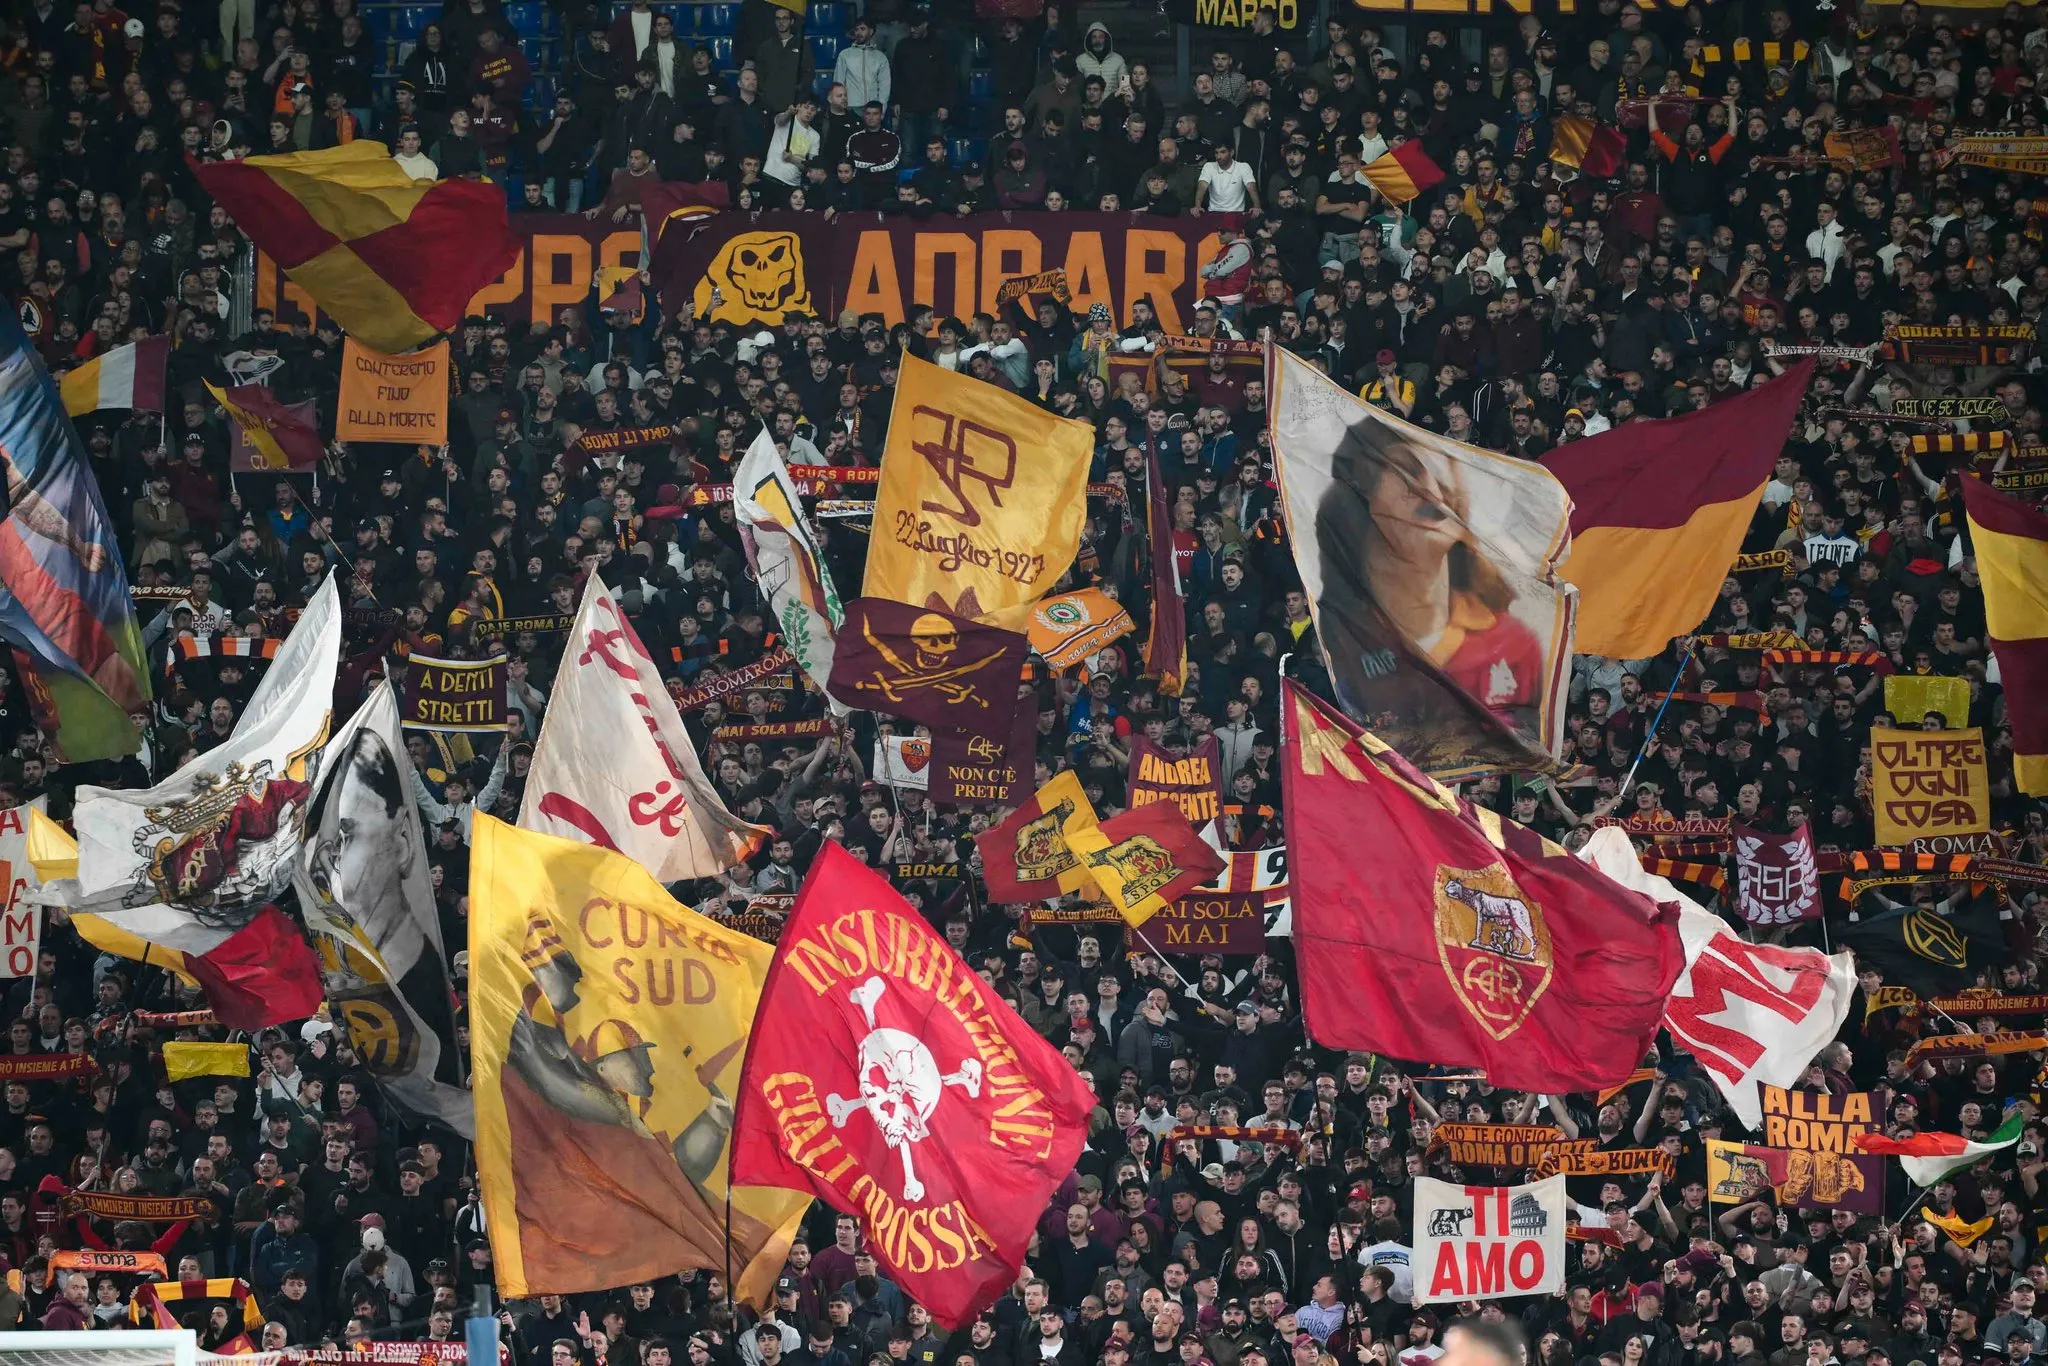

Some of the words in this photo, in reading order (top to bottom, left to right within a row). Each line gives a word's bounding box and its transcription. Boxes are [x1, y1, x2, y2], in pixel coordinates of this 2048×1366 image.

[1233, 342, 1265, 352] AM
[356, 357, 435, 376] CANTEREMO
[377, 386, 409, 400] FINO
[1896, 400, 1918, 415] CHI
[348, 409, 385, 424] ALLA
[389, 412, 436, 427] MORTE
[847, 469, 879, 481] ROM
[896, 510, 915, 547] 22
[913, 522, 994, 572] Luglio
[994, 549, 1045, 585] 1927
[515, 618, 554, 631] ROMA
[1738, 631, 1793, 648] 1927
[420, 668, 433, 690] A
[440, 667, 494, 693] DENTI
[417, 699, 493, 723] STRETTI
[717, 725, 743, 738] MAI
[751, 724, 786, 736] SOLA
[795, 720, 821, 733] MAI
[1877, 740, 1982, 769] OLTRE
[948, 766, 984, 782] NON
[1137, 754, 1211, 786] ANDREA
[955, 784, 1009, 800] PRETE
[1890, 769, 1969, 797] OGNI
[1886, 800, 1976, 828] COSA
[1914, 834, 1993, 854] ROMA
[898, 863, 959, 878] ROMA
[1030, 909, 1055, 920] ROMA
[1058, 910, 1079, 921] CLUB
[1192, 899, 1254, 920] SOLA
[1166, 923, 1231, 944] MAI
[613, 957, 716, 1006] SUD
[1880, 987, 1914, 1004] 927
[1929, 998, 1984, 1012] AMMINERÒ
[1987, 996, 2030, 1010] INSIEME
[2031, 996, 2039, 1008] A
[16, 1060, 57, 1074] INSIEME
[59, 1059, 67, 1071] A
[1764, 1085, 1872, 1122] ALLA
[1472, 1127, 1488, 1142] TE
[1766, 1116, 1868, 1154] ROMA
[1449, 1141, 1507, 1166] ROMA
[1511, 1144, 1524, 1166] O
[139, 1200, 172, 1216] INSIEME
[175, 1201, 181, 1213] A
[1465, 1185, 1509, 1236] TI
[1374, 1256, 1409, 1266] patagonia
[1429, 1240, 1545, 1296] AMO
[287, 1350, 343, 1363] MILANO
[346, 1351, 361, 1363] IN
[364, 1350, 420, 1365] FIAMME
[442, 1343, 469, 1360] ROM
